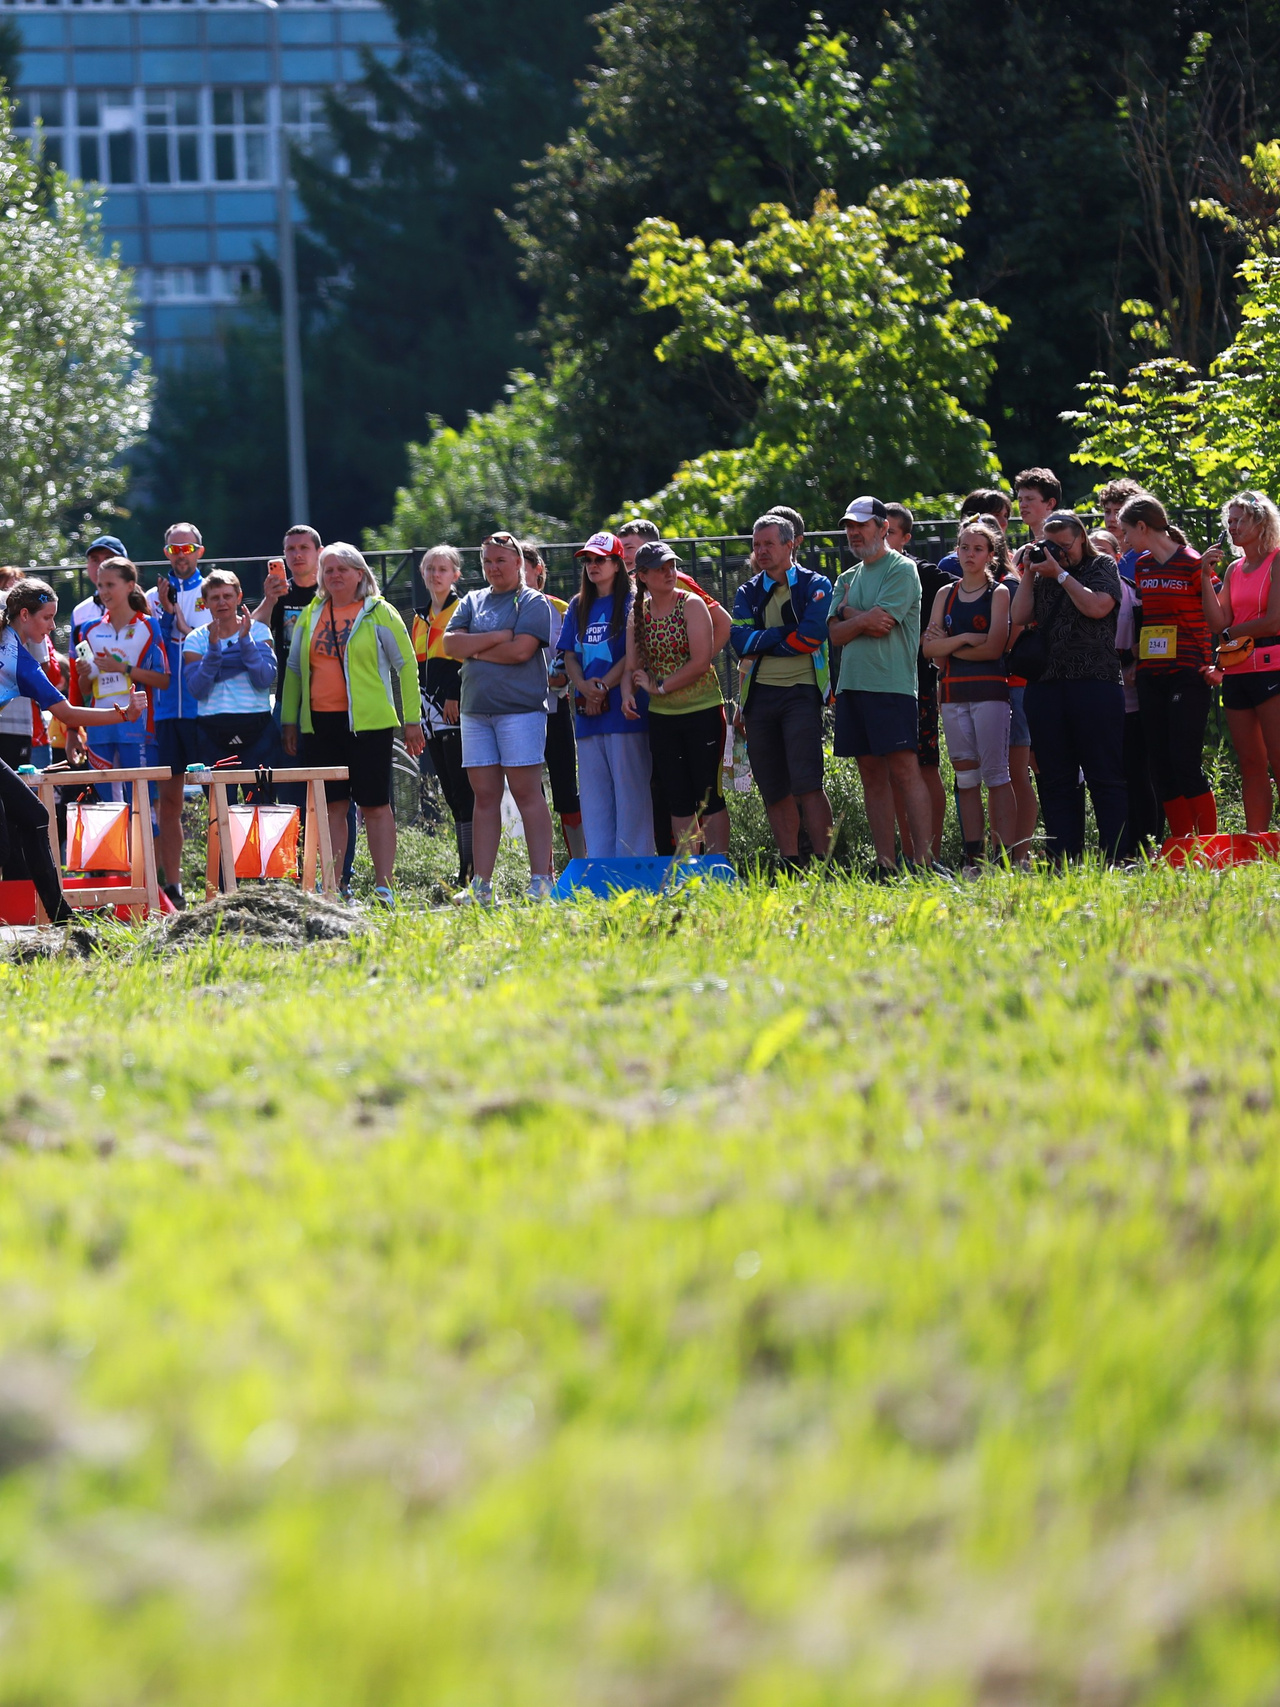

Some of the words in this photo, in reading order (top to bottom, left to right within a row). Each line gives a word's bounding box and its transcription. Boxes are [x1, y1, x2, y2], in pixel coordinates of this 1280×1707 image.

[1160, 578, 1189, 591] WEST
[1149, 641, 1166, 649] 234.1
[101, 675, 119, 686] 220.1
